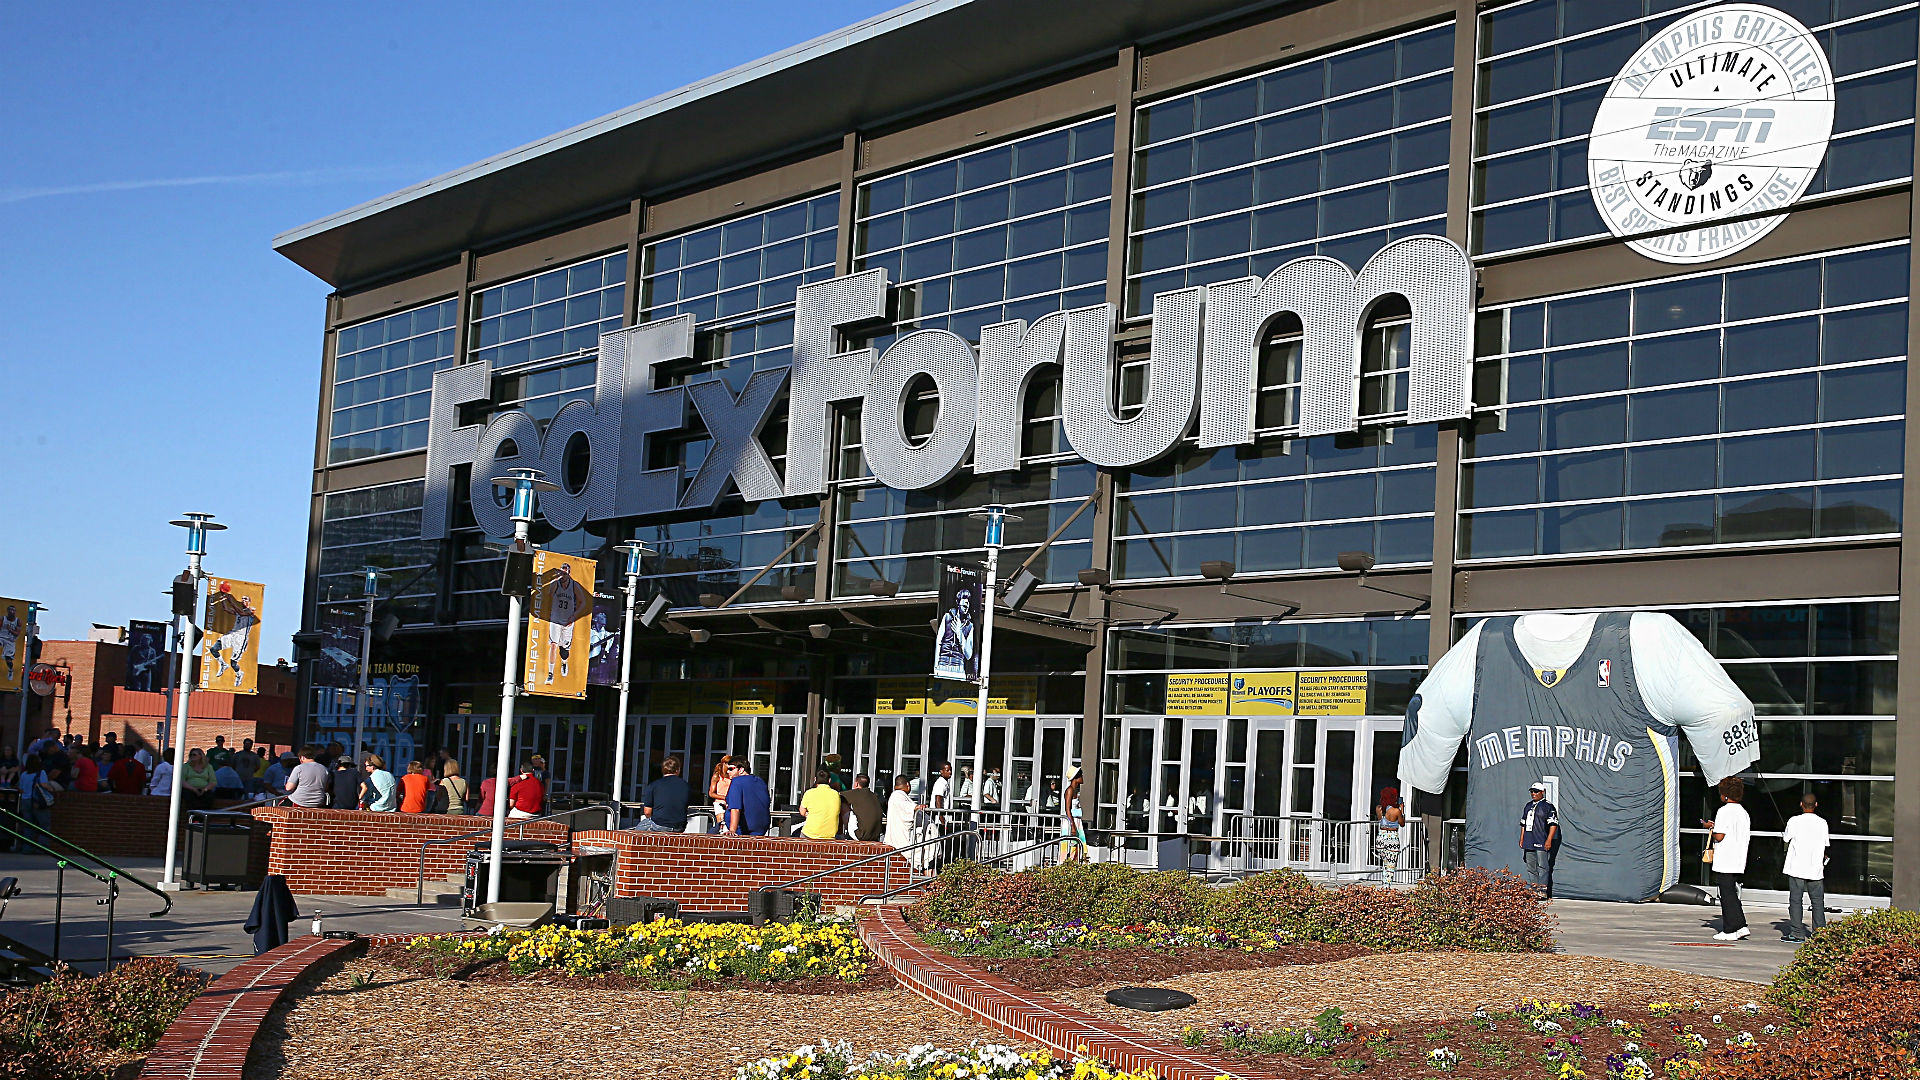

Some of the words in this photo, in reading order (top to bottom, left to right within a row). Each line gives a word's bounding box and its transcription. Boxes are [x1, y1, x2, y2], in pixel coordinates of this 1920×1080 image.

[1624, 15, 1723, 93] MEMPHIS
[1734, 14, 1821, 92] GRIZZLIES
[1670, 51, 1776, 93] ULTIMATE
[1646, 107, 1775, 143] ESPN
[1598, 166, 1631, 213] BEST
[1636, 170, 1754, 215] STANDINGS
[420, 233, 1476, 541] FedExForum
[533, 552, 546, 624] MEMPHIS
[558, 600, 569, 610] 33
[202, 639, 212, 688] BELIEVE
[207, 579, 217, 635] MEMPHIS
[374, 663, 394, 674] TEAM
[397, 663, 420, 673] STORE
[528, 630, 540, 692] BELIEVE
[1247, 686, 1292, 696] PLAYOFFS
[1476, 725, 1633, 772] MEMPHIS
